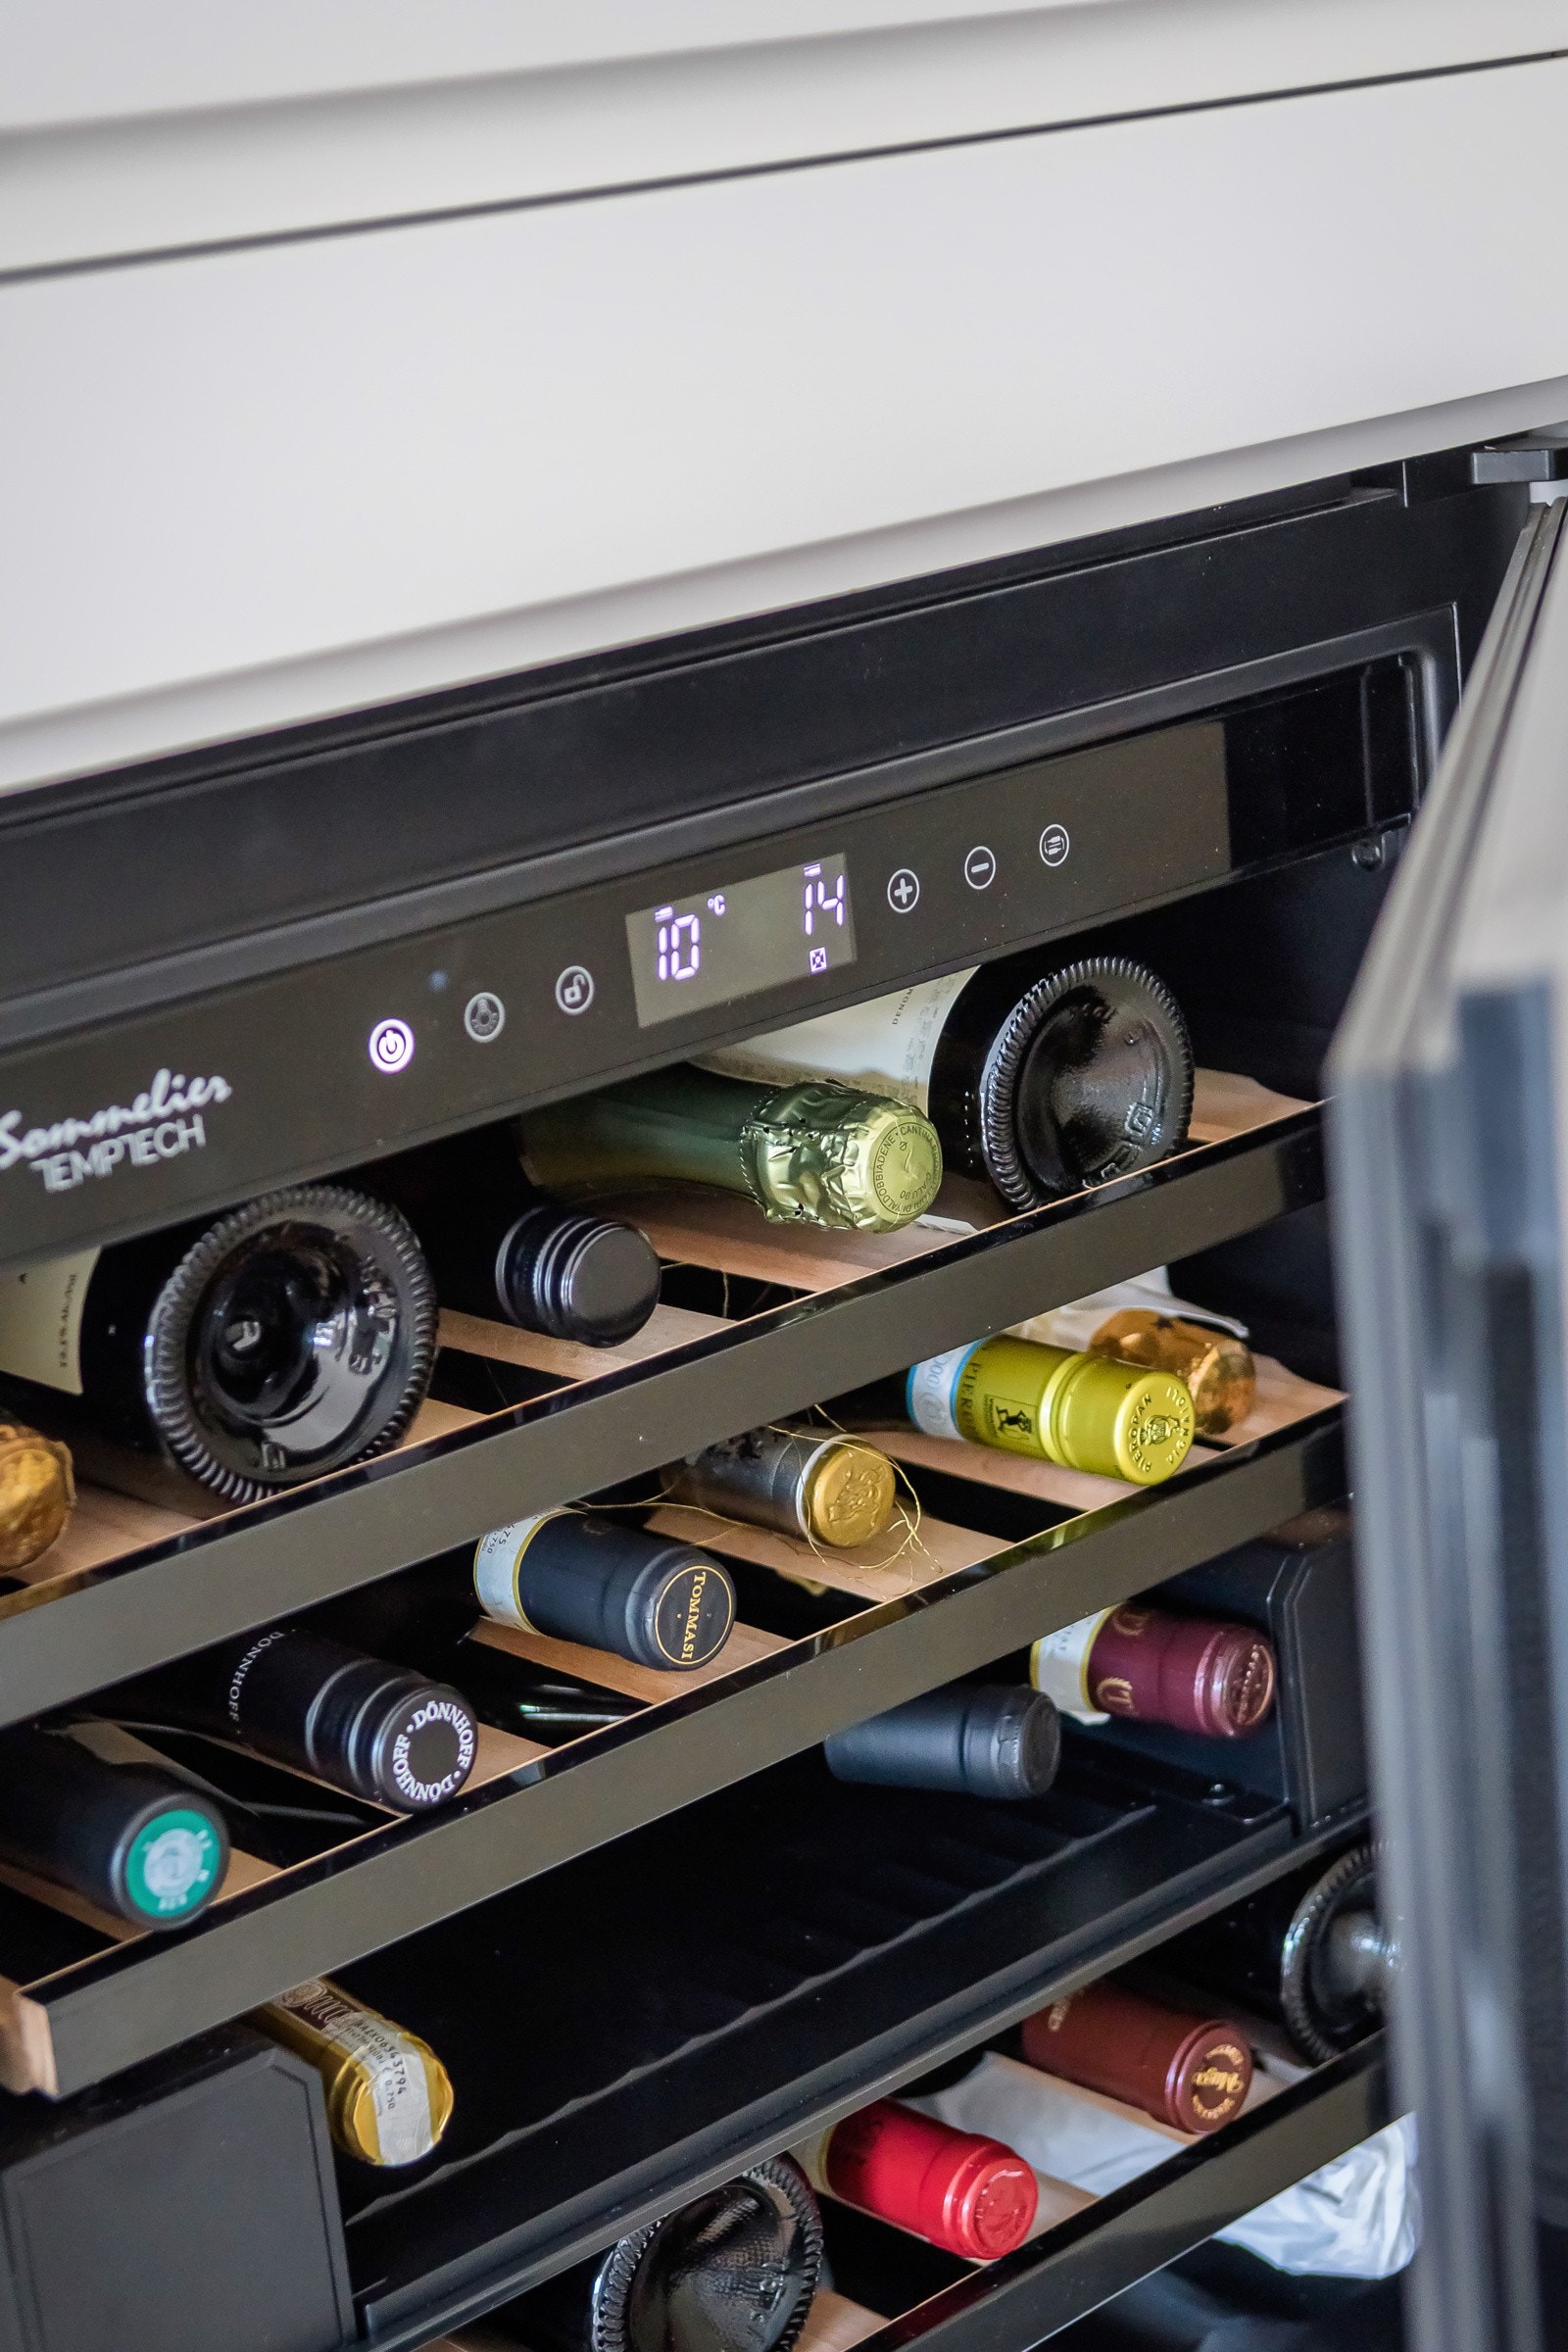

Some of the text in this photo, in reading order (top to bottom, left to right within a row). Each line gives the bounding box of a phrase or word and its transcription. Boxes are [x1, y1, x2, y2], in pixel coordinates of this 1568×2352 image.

[804, 873, 845, 937] 14
[657, 912, 701, 981] 10
[0, 1067, 233, 1171] Sommelier
[27, 1113, 206, 1193] TEMPTECH
[900, 1125, 933, 1147] CANTINA
[875, 1134, 902, 1212] VALDOBBIADENE
[1129, 1393, 1152, 1472] PIEROPAN
[681, 1571, 707, 1660] TOMMASI
